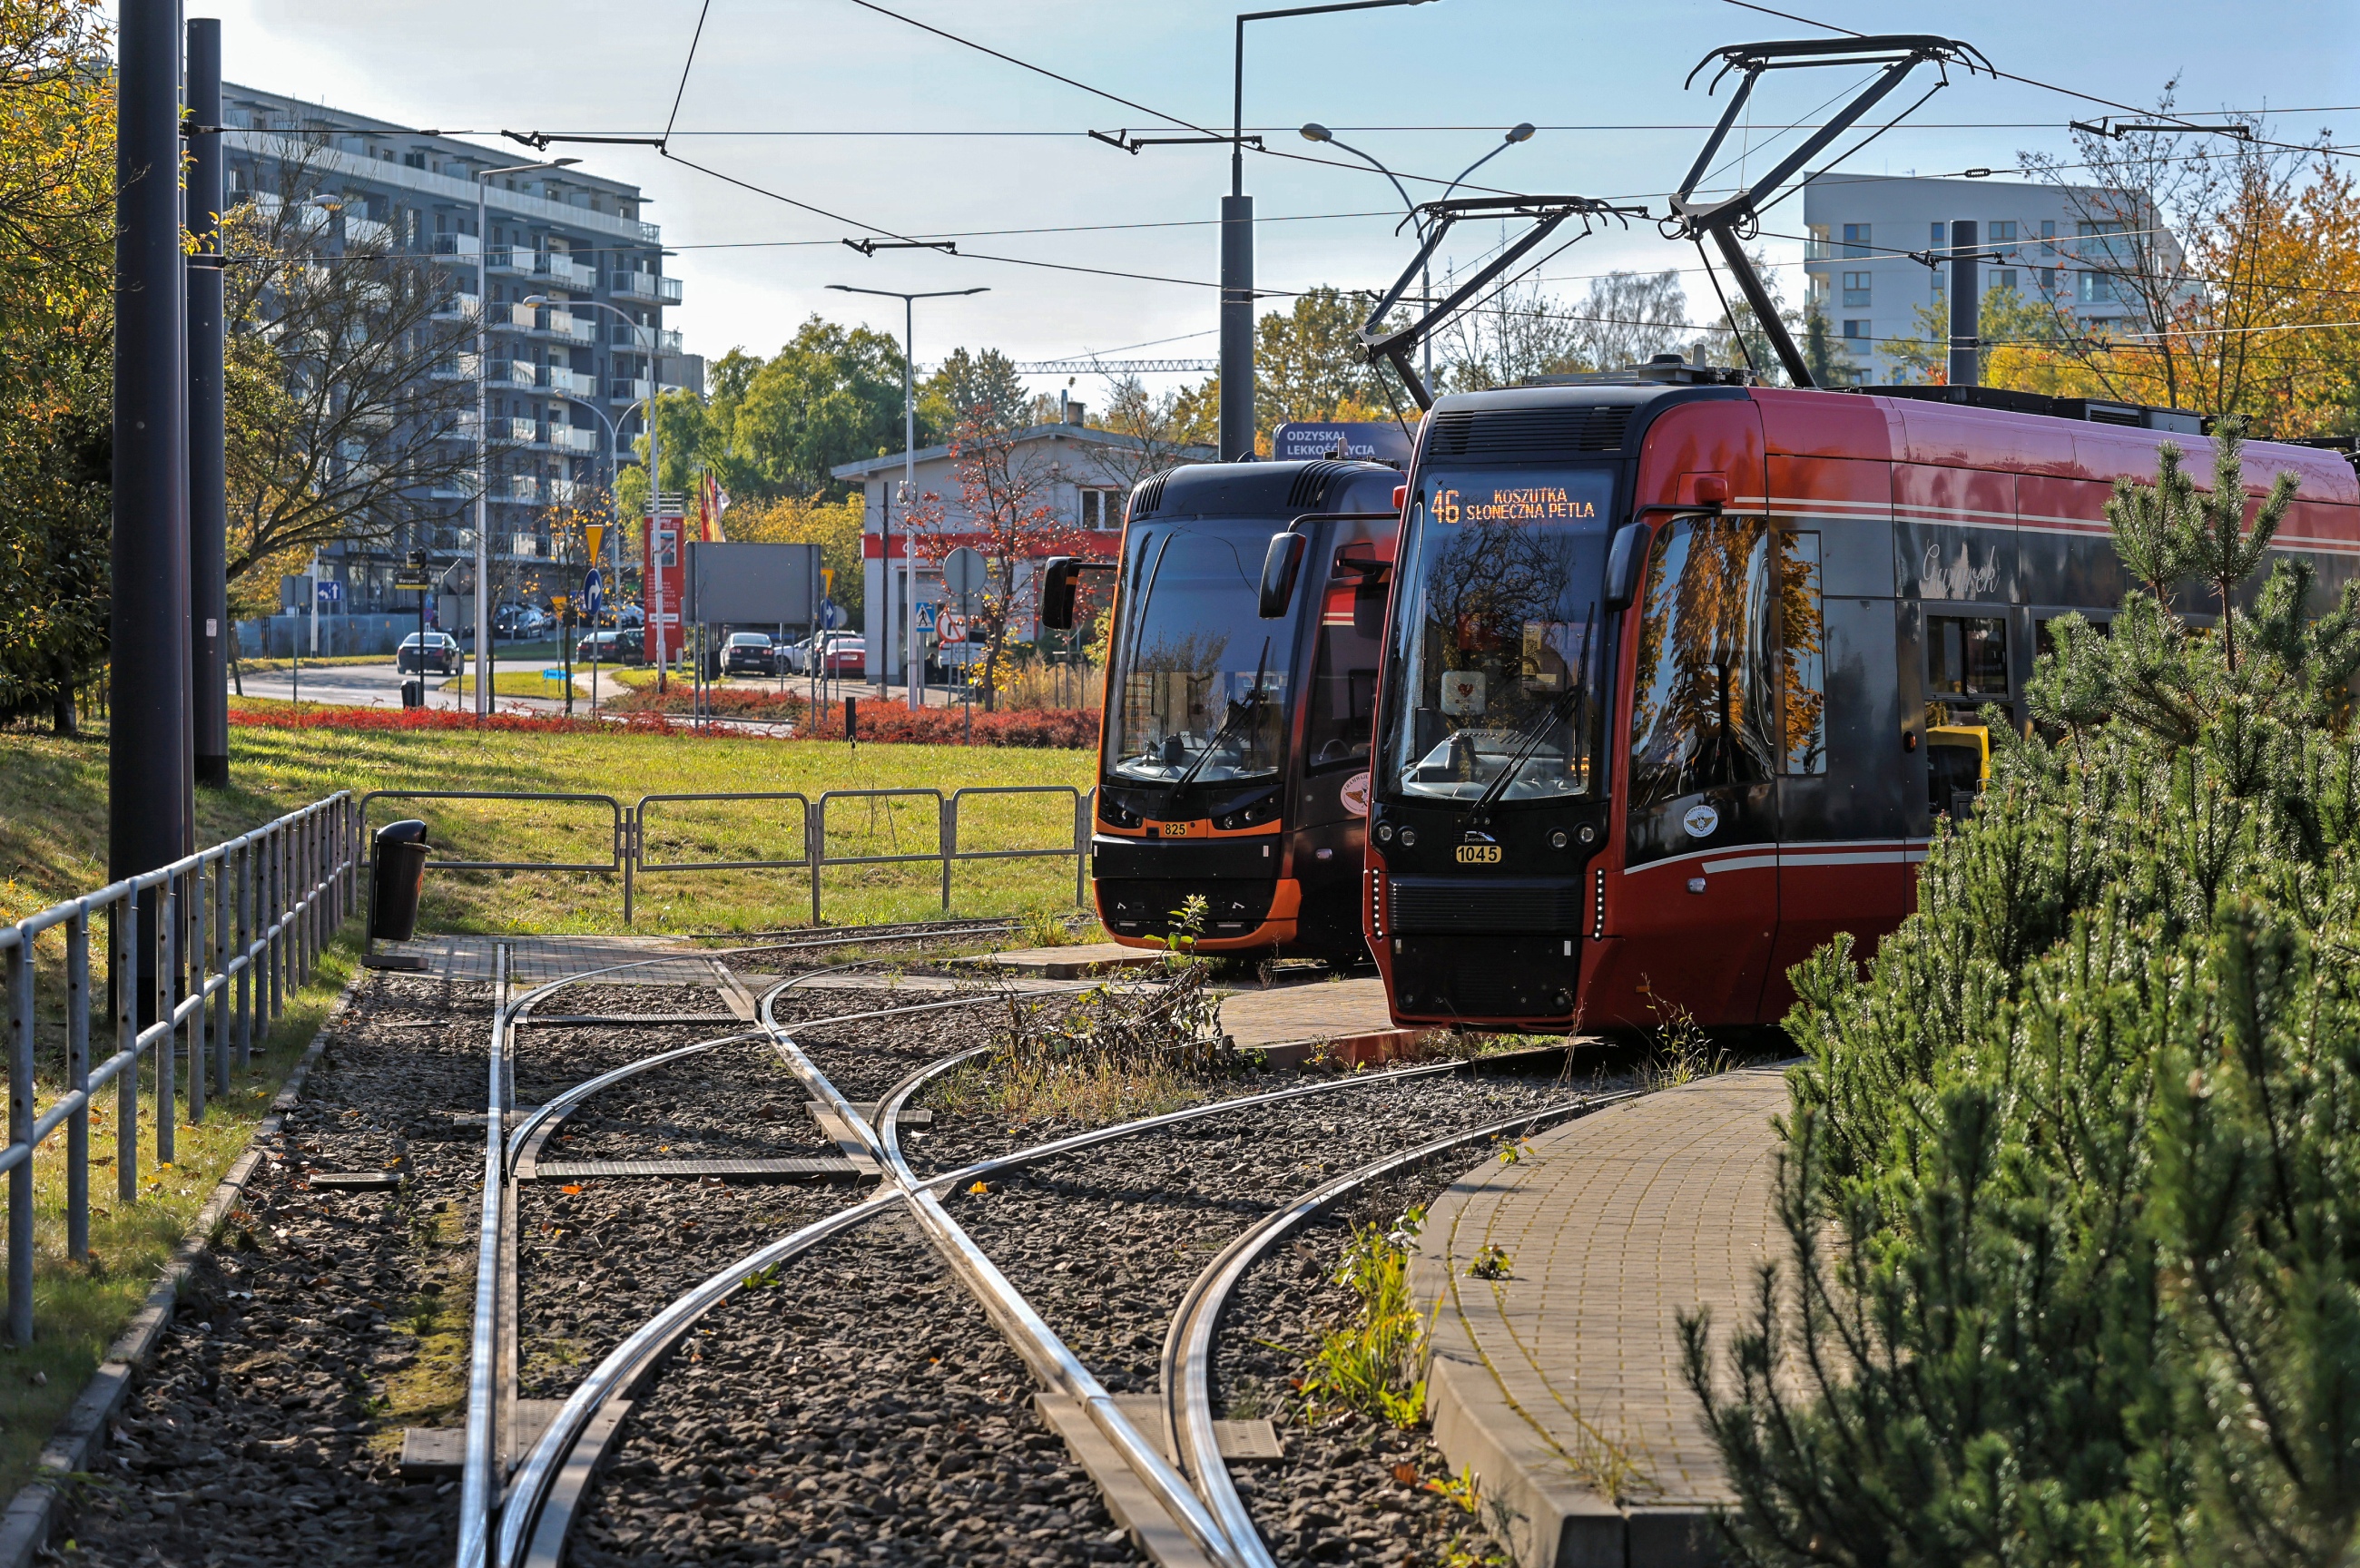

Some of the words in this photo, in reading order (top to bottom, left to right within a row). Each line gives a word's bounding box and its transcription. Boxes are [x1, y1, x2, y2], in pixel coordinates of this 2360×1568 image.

[1347, 445, 1375, 455] YCIA
[1494, 487, 1568, 505] KOSZUTKA
[1431, 490, 1460, 524] 46
[1467, 504, 1545, 520] SŁONECZNA
[1919, 539, 2001, 593] Gwarek
[1343, 774, 1368, 791] TRAMWAJE
[1165, 823, 1186, 835] 825
[1458, 847, 1498, 862] 1045
